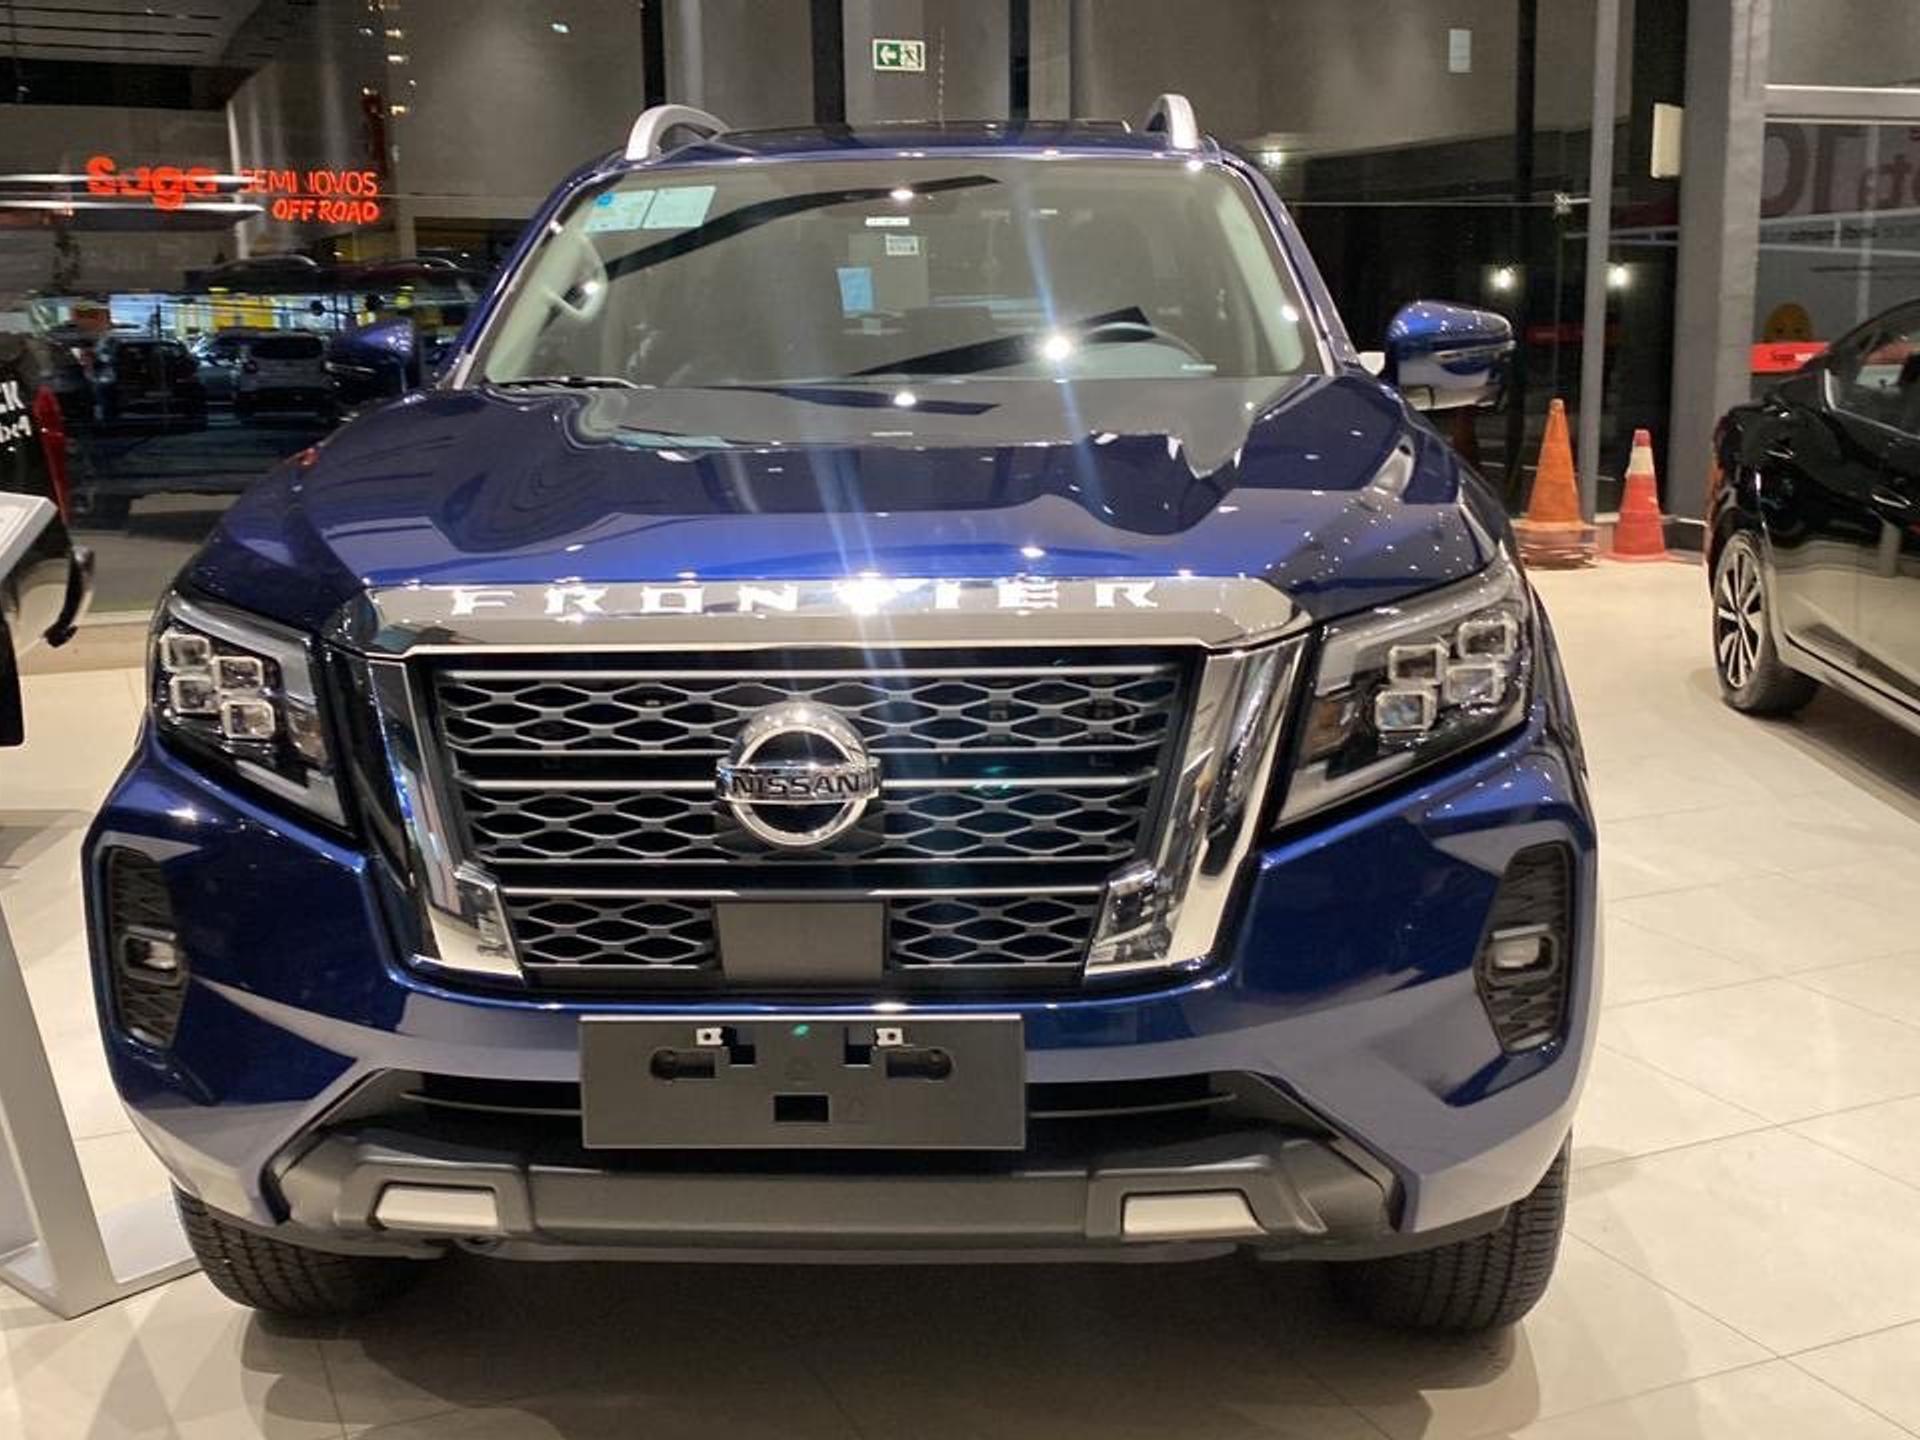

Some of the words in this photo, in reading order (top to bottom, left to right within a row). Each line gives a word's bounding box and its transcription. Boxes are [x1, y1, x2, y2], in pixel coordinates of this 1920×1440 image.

[271, 198, 316, 221] OFF
[317, 199, 380, 225] ROAD
[452, 580, 1159, 616] FRONTIER
[731, 774, 860, 795] NISSAN
